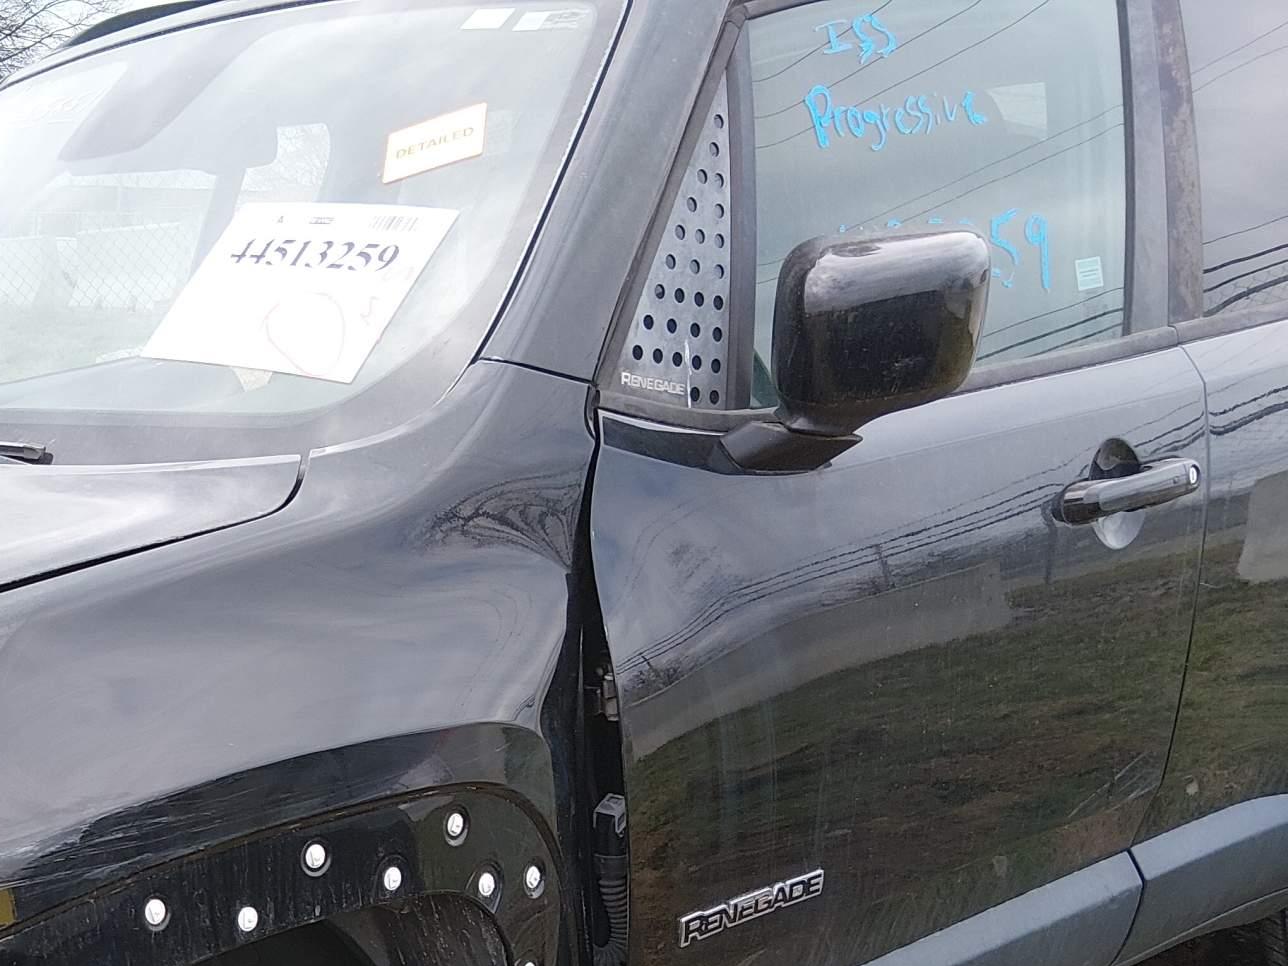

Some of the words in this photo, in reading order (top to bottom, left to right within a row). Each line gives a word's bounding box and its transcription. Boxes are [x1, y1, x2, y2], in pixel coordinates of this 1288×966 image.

[804, 85, 988, 151] Progressive
[395, 127, 474, 159] DETAILED
[230, 238, 400, 272] 44513259
[620, 371, 686, 395] RENEGADE
[680, 869, 825, 948] RENEGADE
